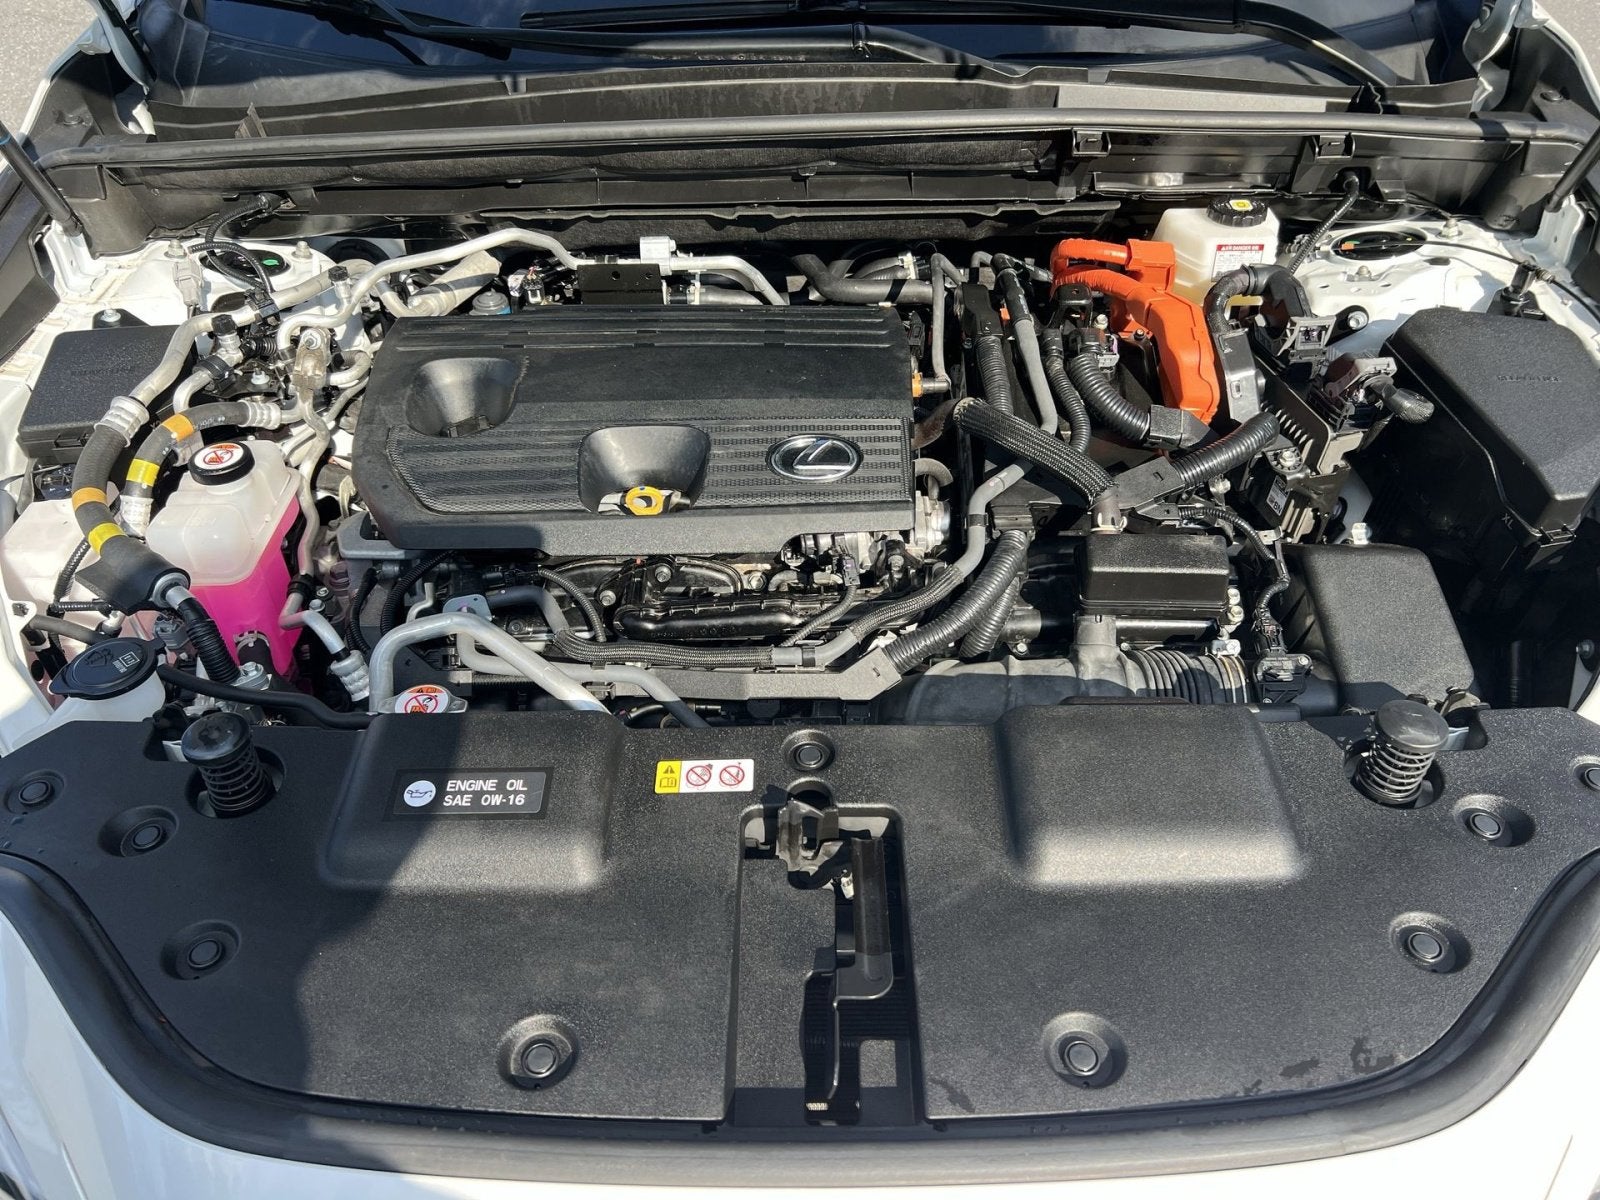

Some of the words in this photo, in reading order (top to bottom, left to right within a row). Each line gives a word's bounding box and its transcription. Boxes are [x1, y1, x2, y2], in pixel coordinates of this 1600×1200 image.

[446, 779, 498, 792] ENGINE
[506, 779, 528, 791] OIL
[442, 794, 473, 807] SAE
[480, 793, 526, 806] 0W-16
